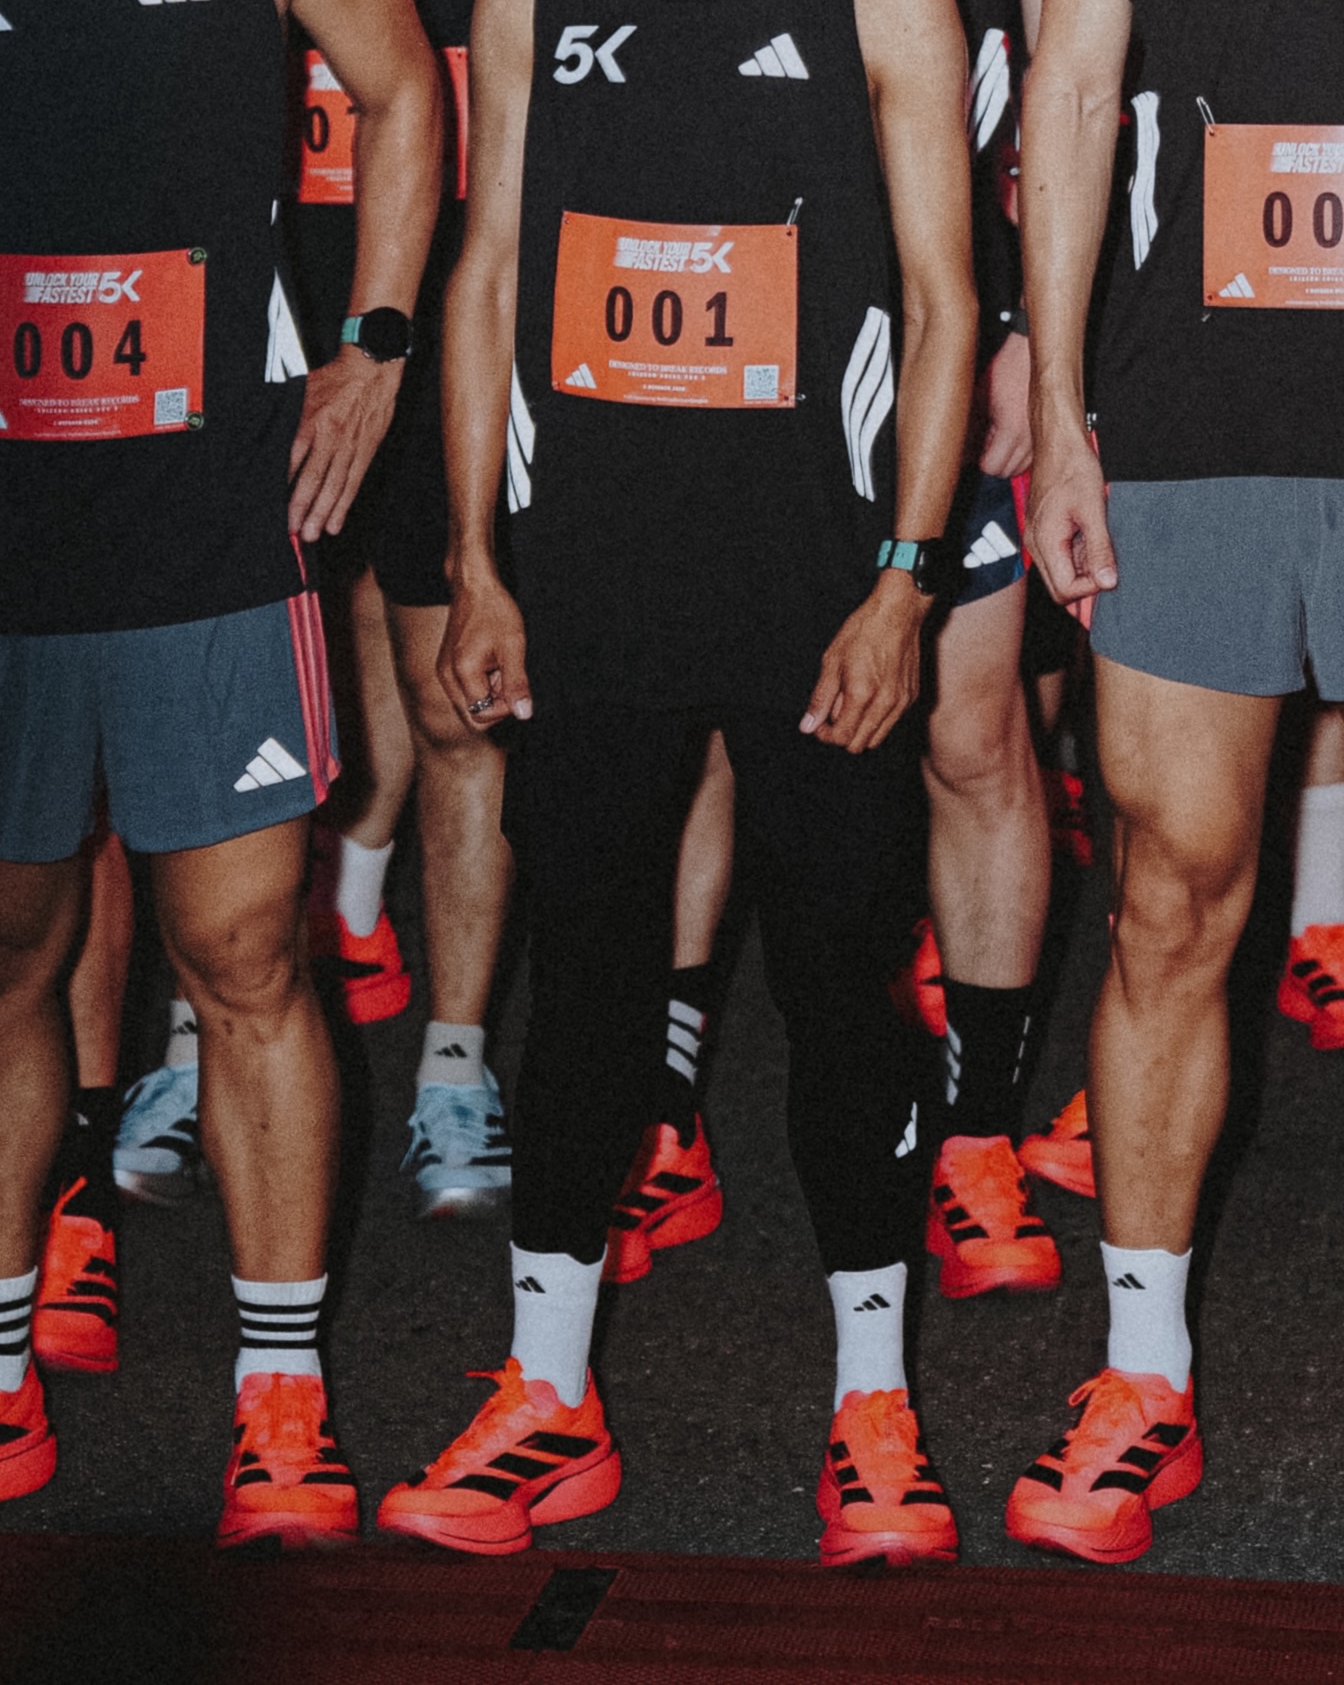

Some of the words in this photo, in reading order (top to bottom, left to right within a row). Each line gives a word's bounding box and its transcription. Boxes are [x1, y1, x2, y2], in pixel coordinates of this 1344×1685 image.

[553, 25, 638, 85] 5K
[689, 240, 735, 274] 5K
[25, 272, 68, 286] UNLOCK
[70, 271, 99, 285] YOUR
[37, 285, 96, 303] FASTEST
[98, 269, 143, 304] 5K
[605, 285, 734, 347] 001
[13, 319, 147, 381] 004
